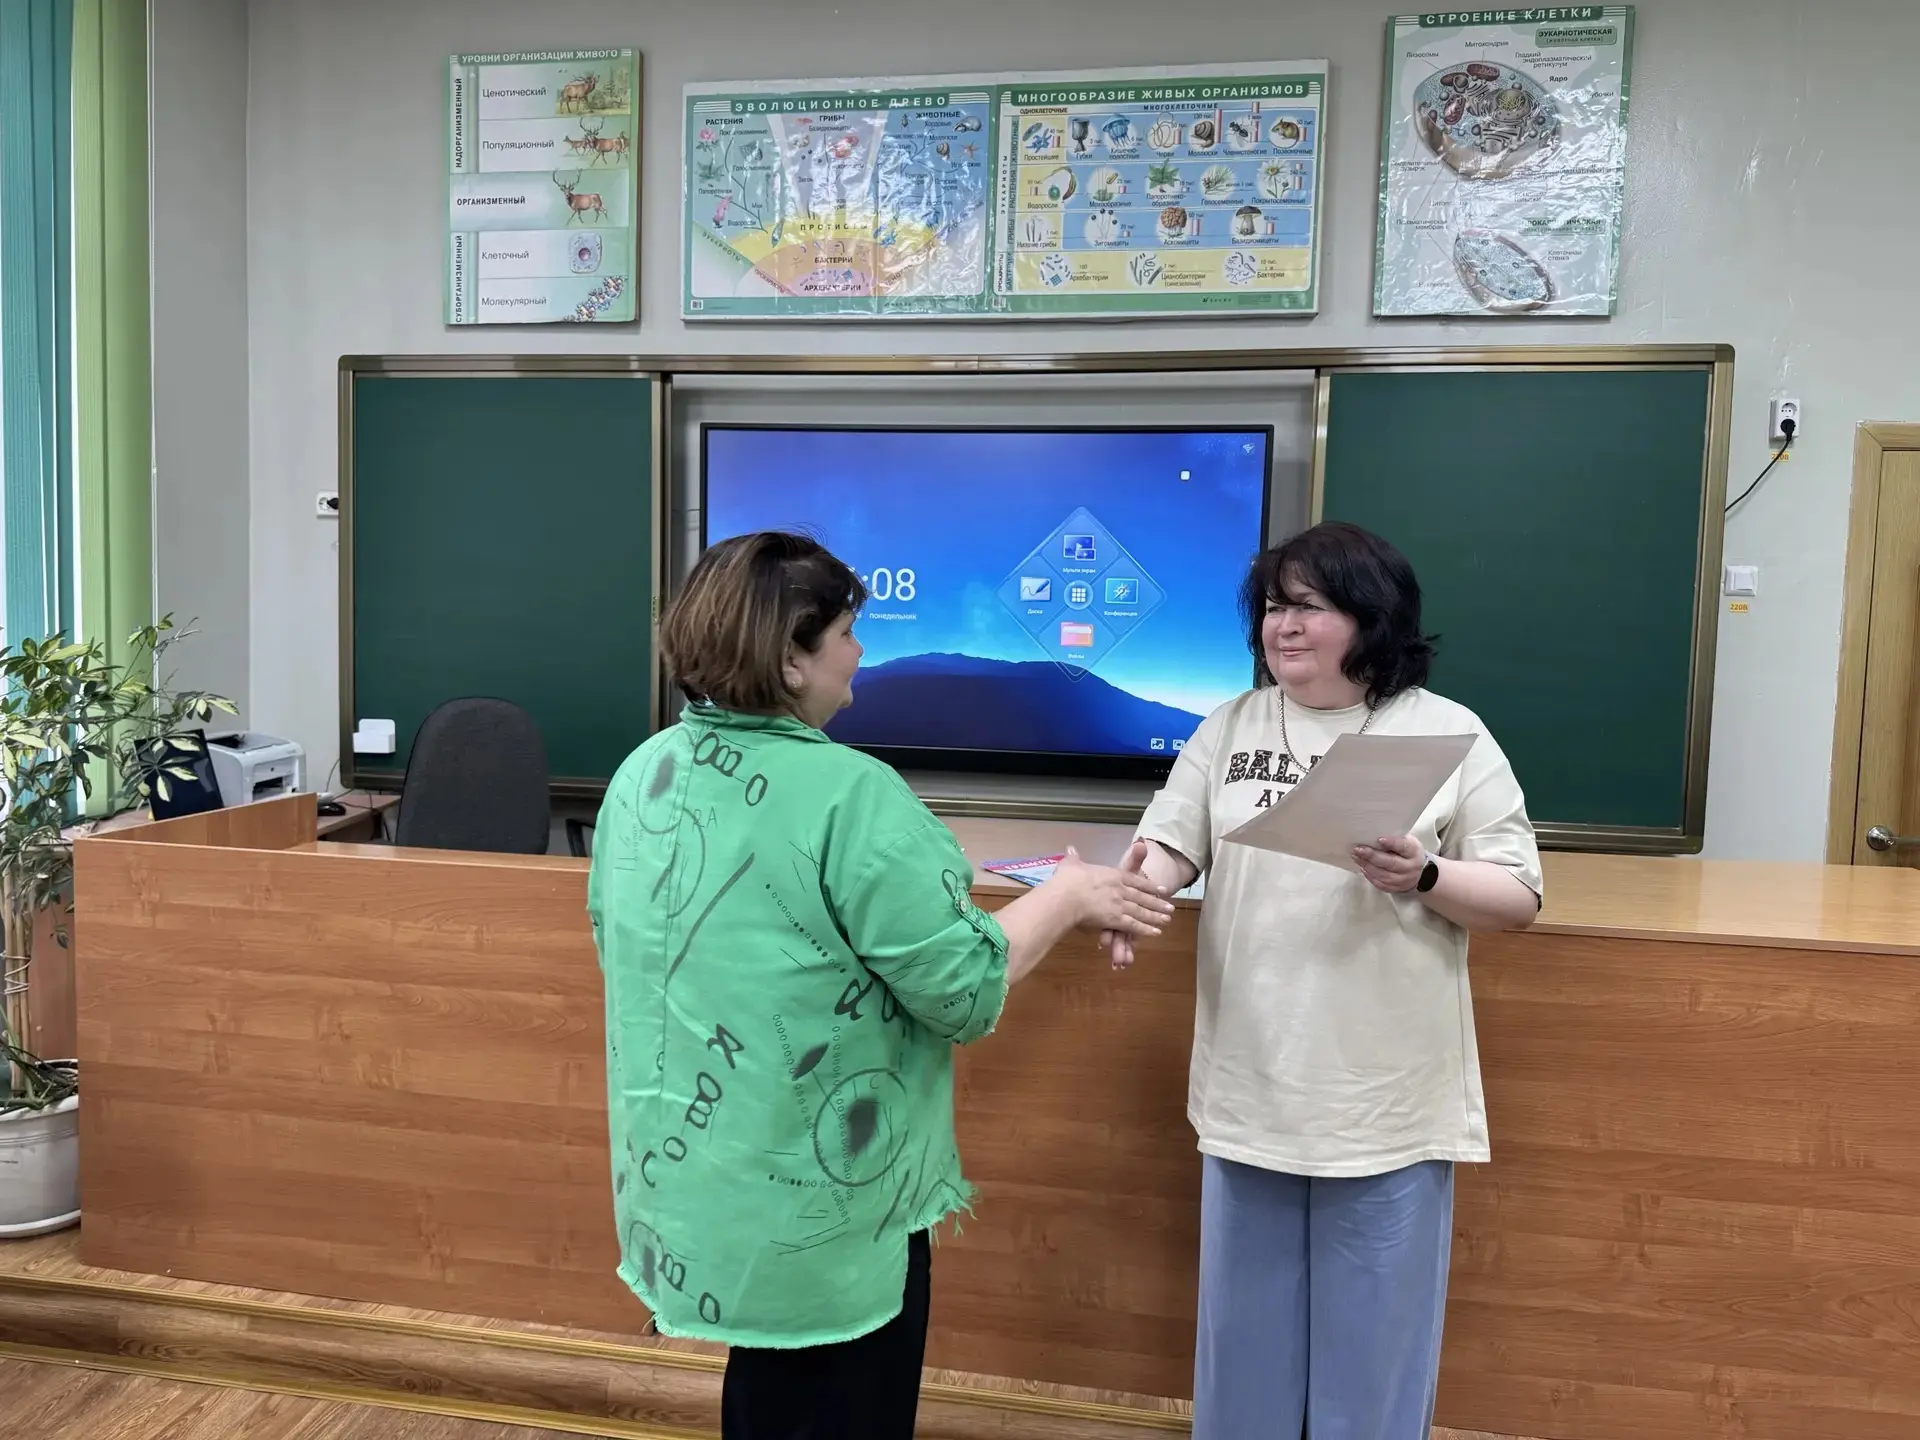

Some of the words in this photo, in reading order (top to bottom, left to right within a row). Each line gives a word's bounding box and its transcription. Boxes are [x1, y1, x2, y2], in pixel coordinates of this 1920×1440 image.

[1426, 11, 1516, 24] СТРОЕНИЕ
[1524, 8, 1592, 20] КЛЕТКИ
[1538, 28, 1612, 38] ЭУКАРИОТИЧЕСКАЯ
[462, 54, 500, 64] УРОВНИ
[502, 52, 574, 62] ОРГАНИЗАЦИИ
[576, 50, 618, 60] ЖИВОГО
[482, 86, 547, 98] Ценотический
[1018, 91, 1136, 103] МНОГООБРАЗИЕ
[1142, 88, 1196, 99] ЖИВЫХ
[1202, 85, 1304, 97] ОРГАНИЗМОВ
[735, 99, 878, 112] ЭВОЛЮЦИОННОЕ
[482, 140, 554, 151] Популяционный
[1009, 170, 1017, 208] РАСТЕНИЯ
[456, 196, 526, 206] ОРГАНИЗМЕННЫЙ
[482, 251, 529, 260] Клеточный
[481, 296, 547, 307] Молекулярный
[847, 567, 916, 601] :08
[1224, 750, 1323, 785] BAL
